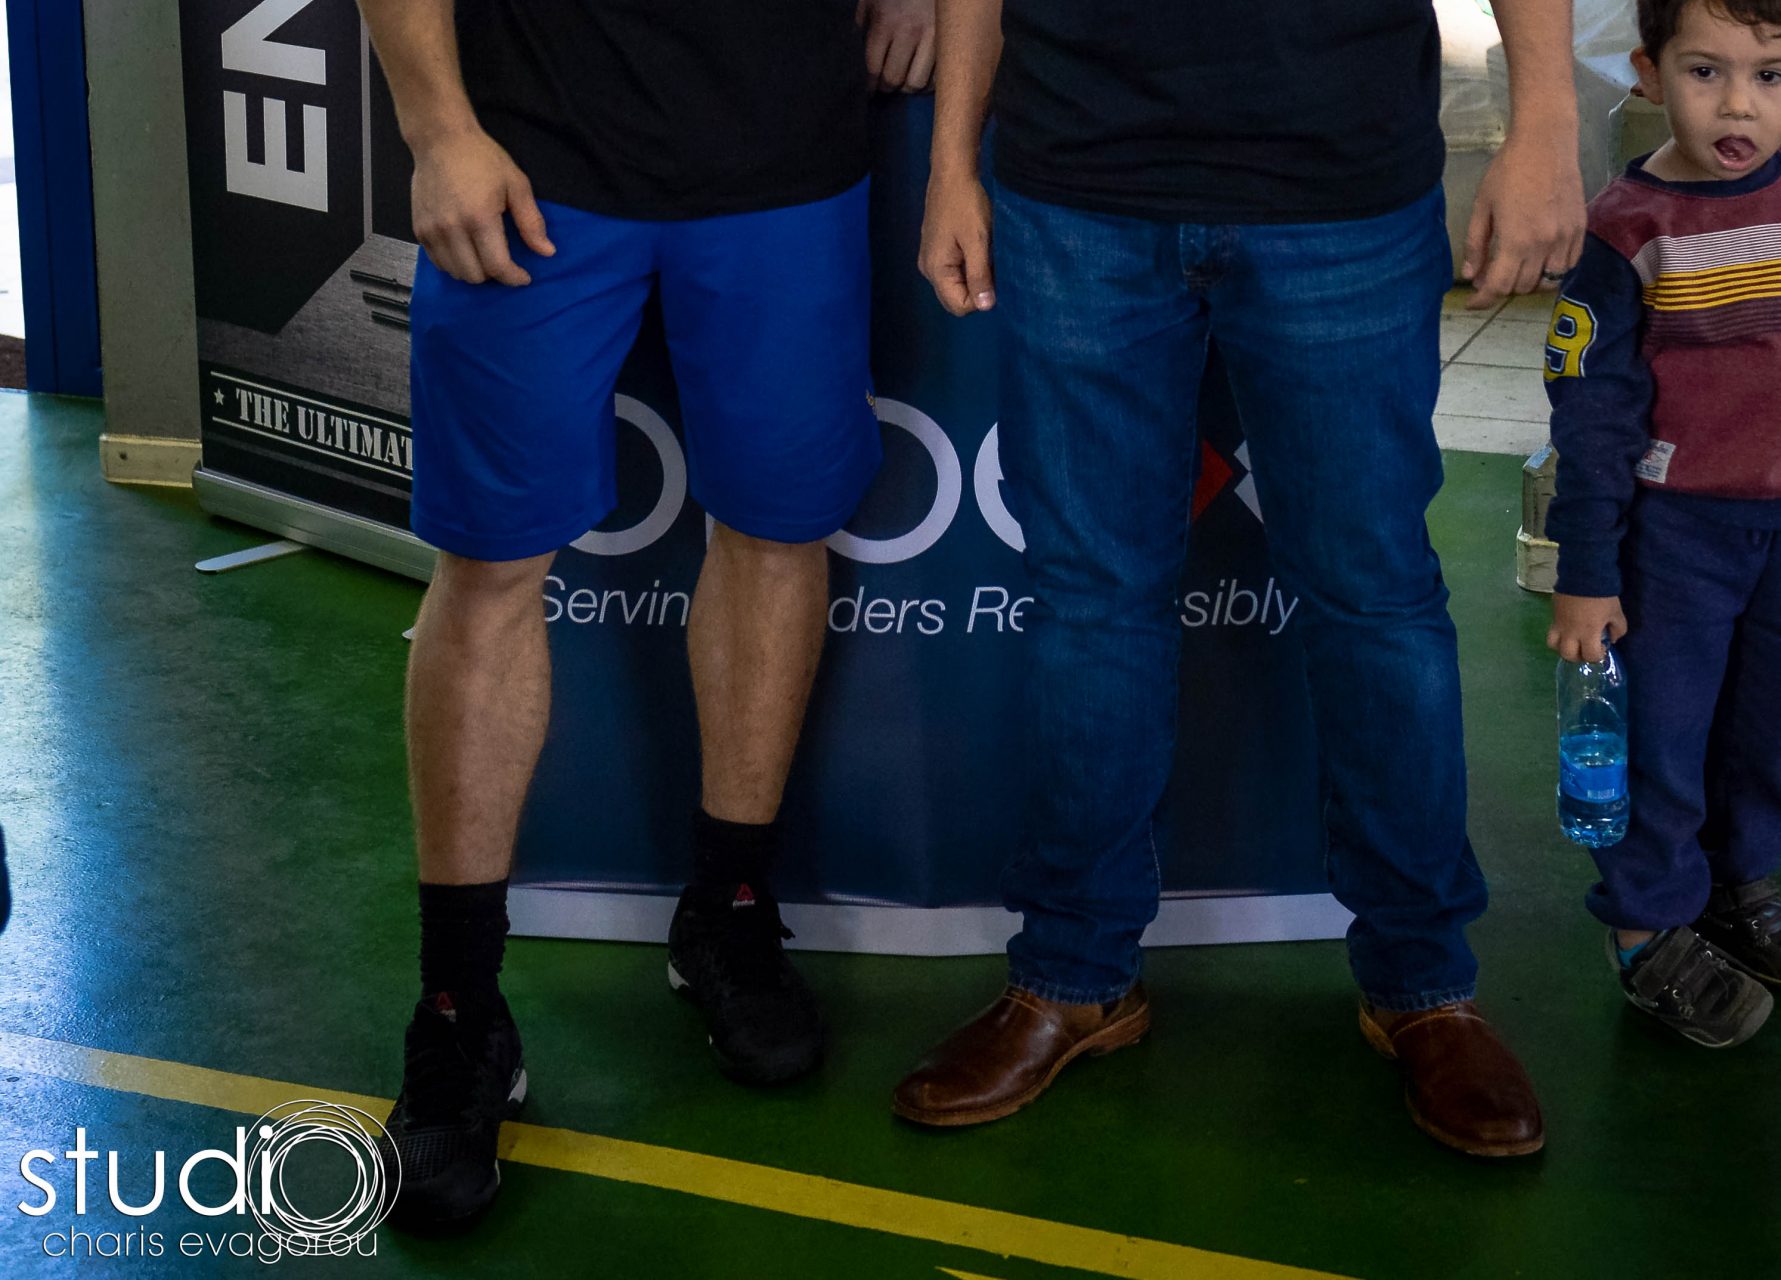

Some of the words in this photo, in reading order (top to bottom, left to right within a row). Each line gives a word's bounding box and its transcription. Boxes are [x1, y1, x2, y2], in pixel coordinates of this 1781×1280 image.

[236, 388, 290, 433] THE
[297, 404, 413, 470] ULTIMAT
[542, 576, 690, 626] Servin
[828, 586, 946, 635] ders
[966, 578, 1299, 635] Resibly
